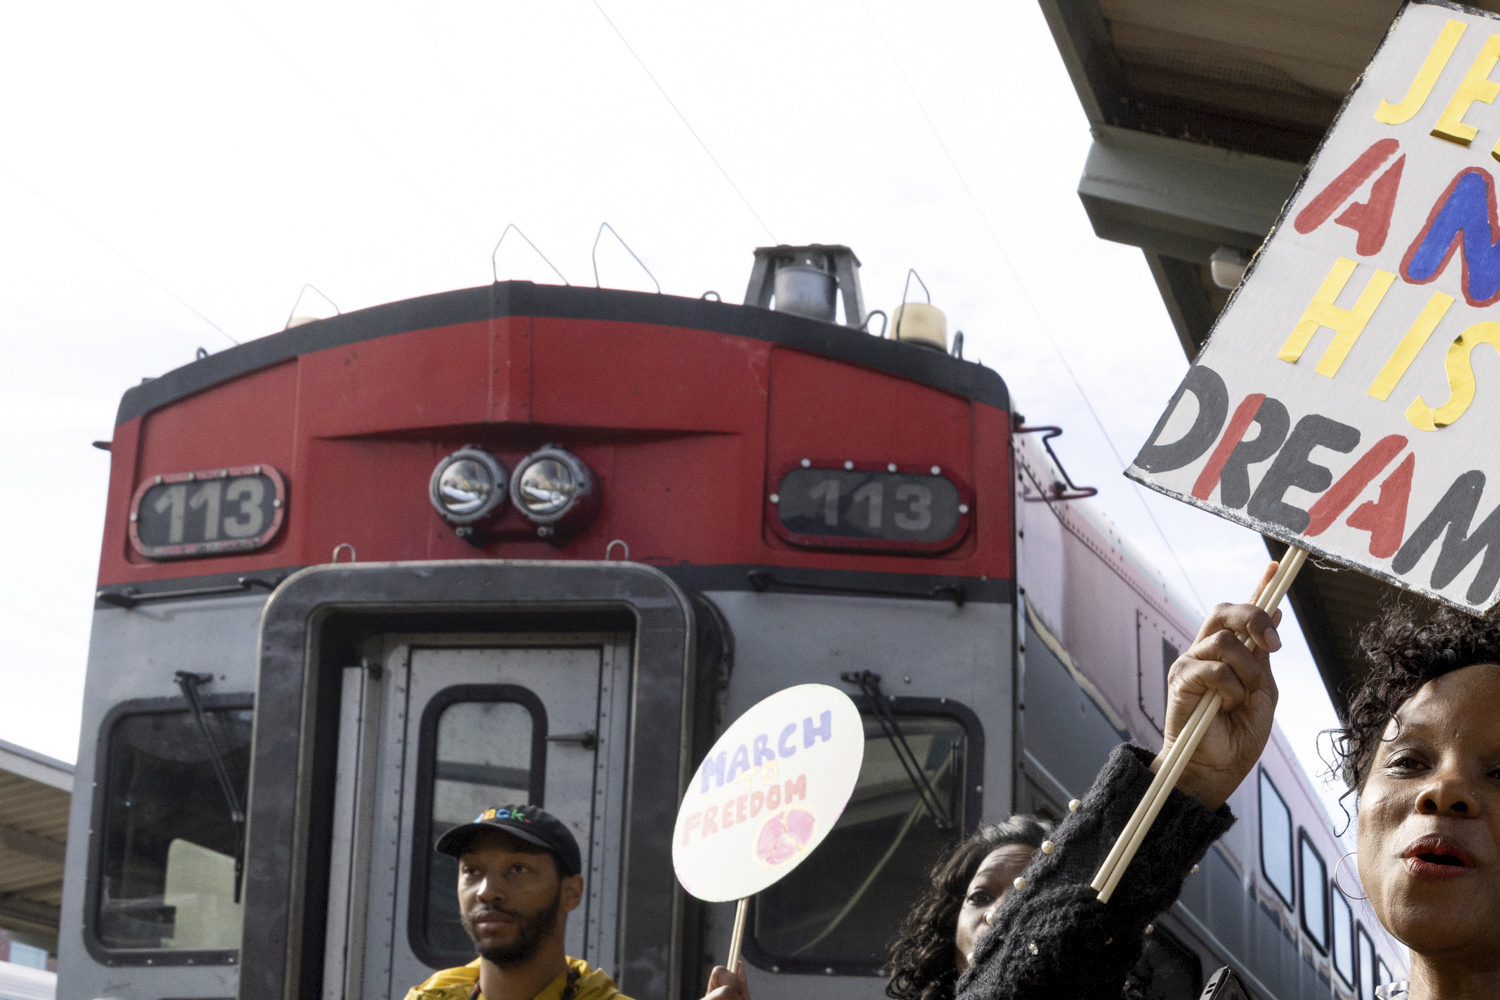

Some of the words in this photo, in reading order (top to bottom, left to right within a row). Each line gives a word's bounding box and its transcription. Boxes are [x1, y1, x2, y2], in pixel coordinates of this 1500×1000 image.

[153, 478, 266, 544] 113
[807, 478, 933, 531] 113
[700, 709, 832, 795] MARCH
[682, 773, 807, 847] FREEDOM
